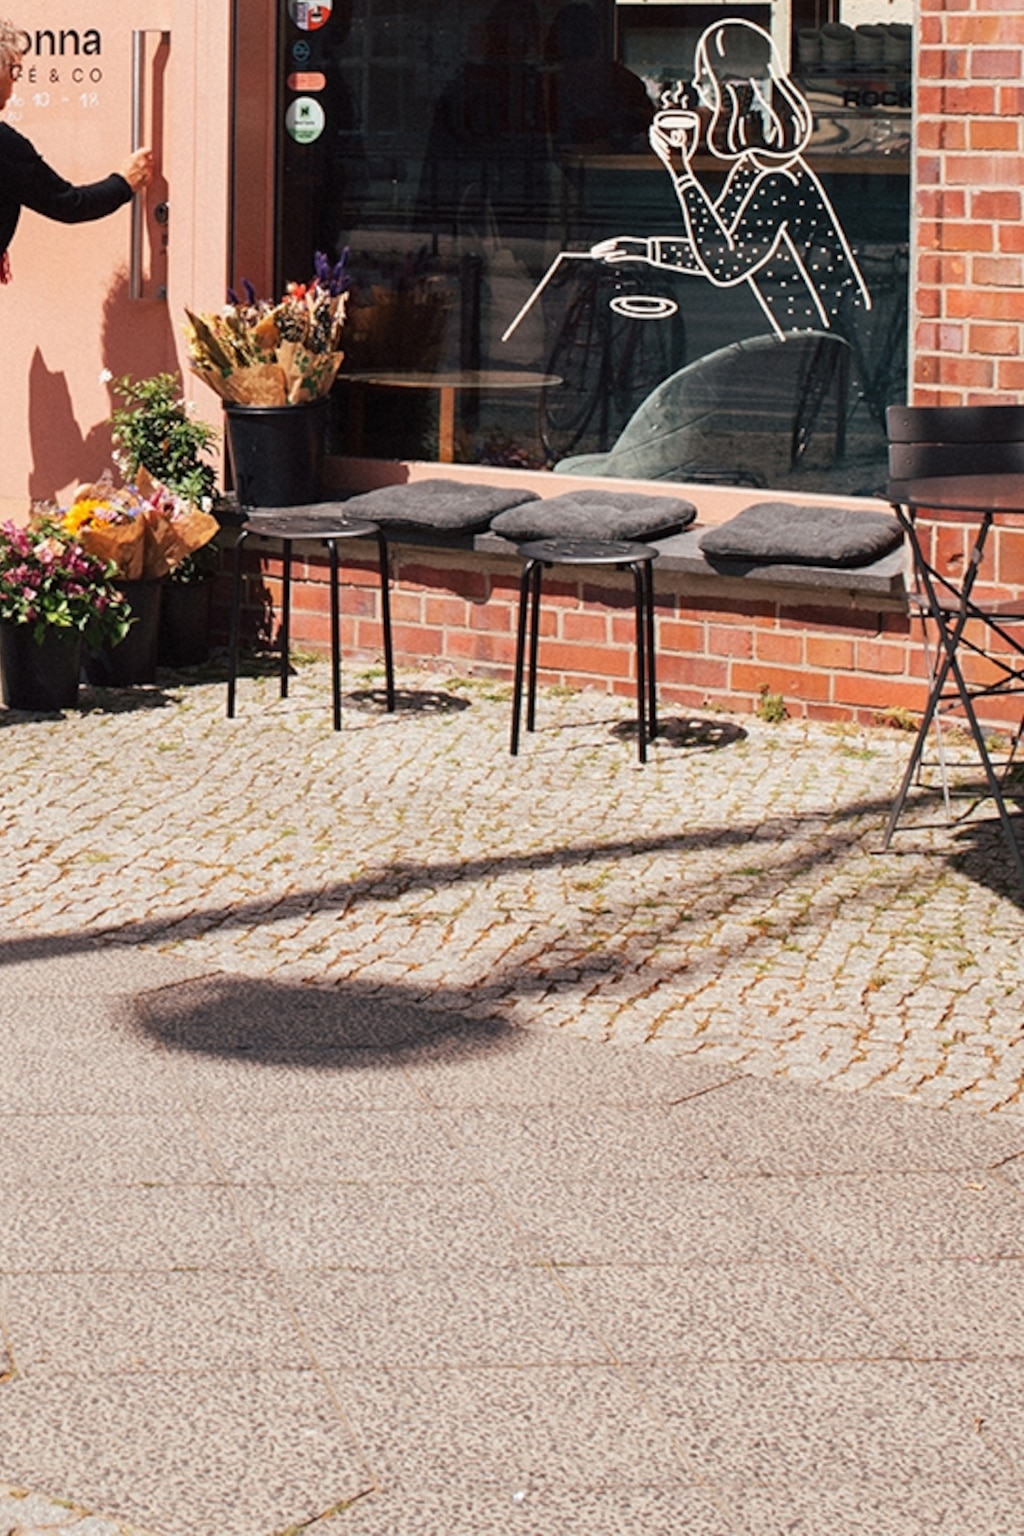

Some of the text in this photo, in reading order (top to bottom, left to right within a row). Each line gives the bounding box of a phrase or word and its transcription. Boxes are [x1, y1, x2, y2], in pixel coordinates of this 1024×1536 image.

[21, 28, 101, 55] onna
[49, 68, 60, 83] &
[72, 68, 103, 83] CO
